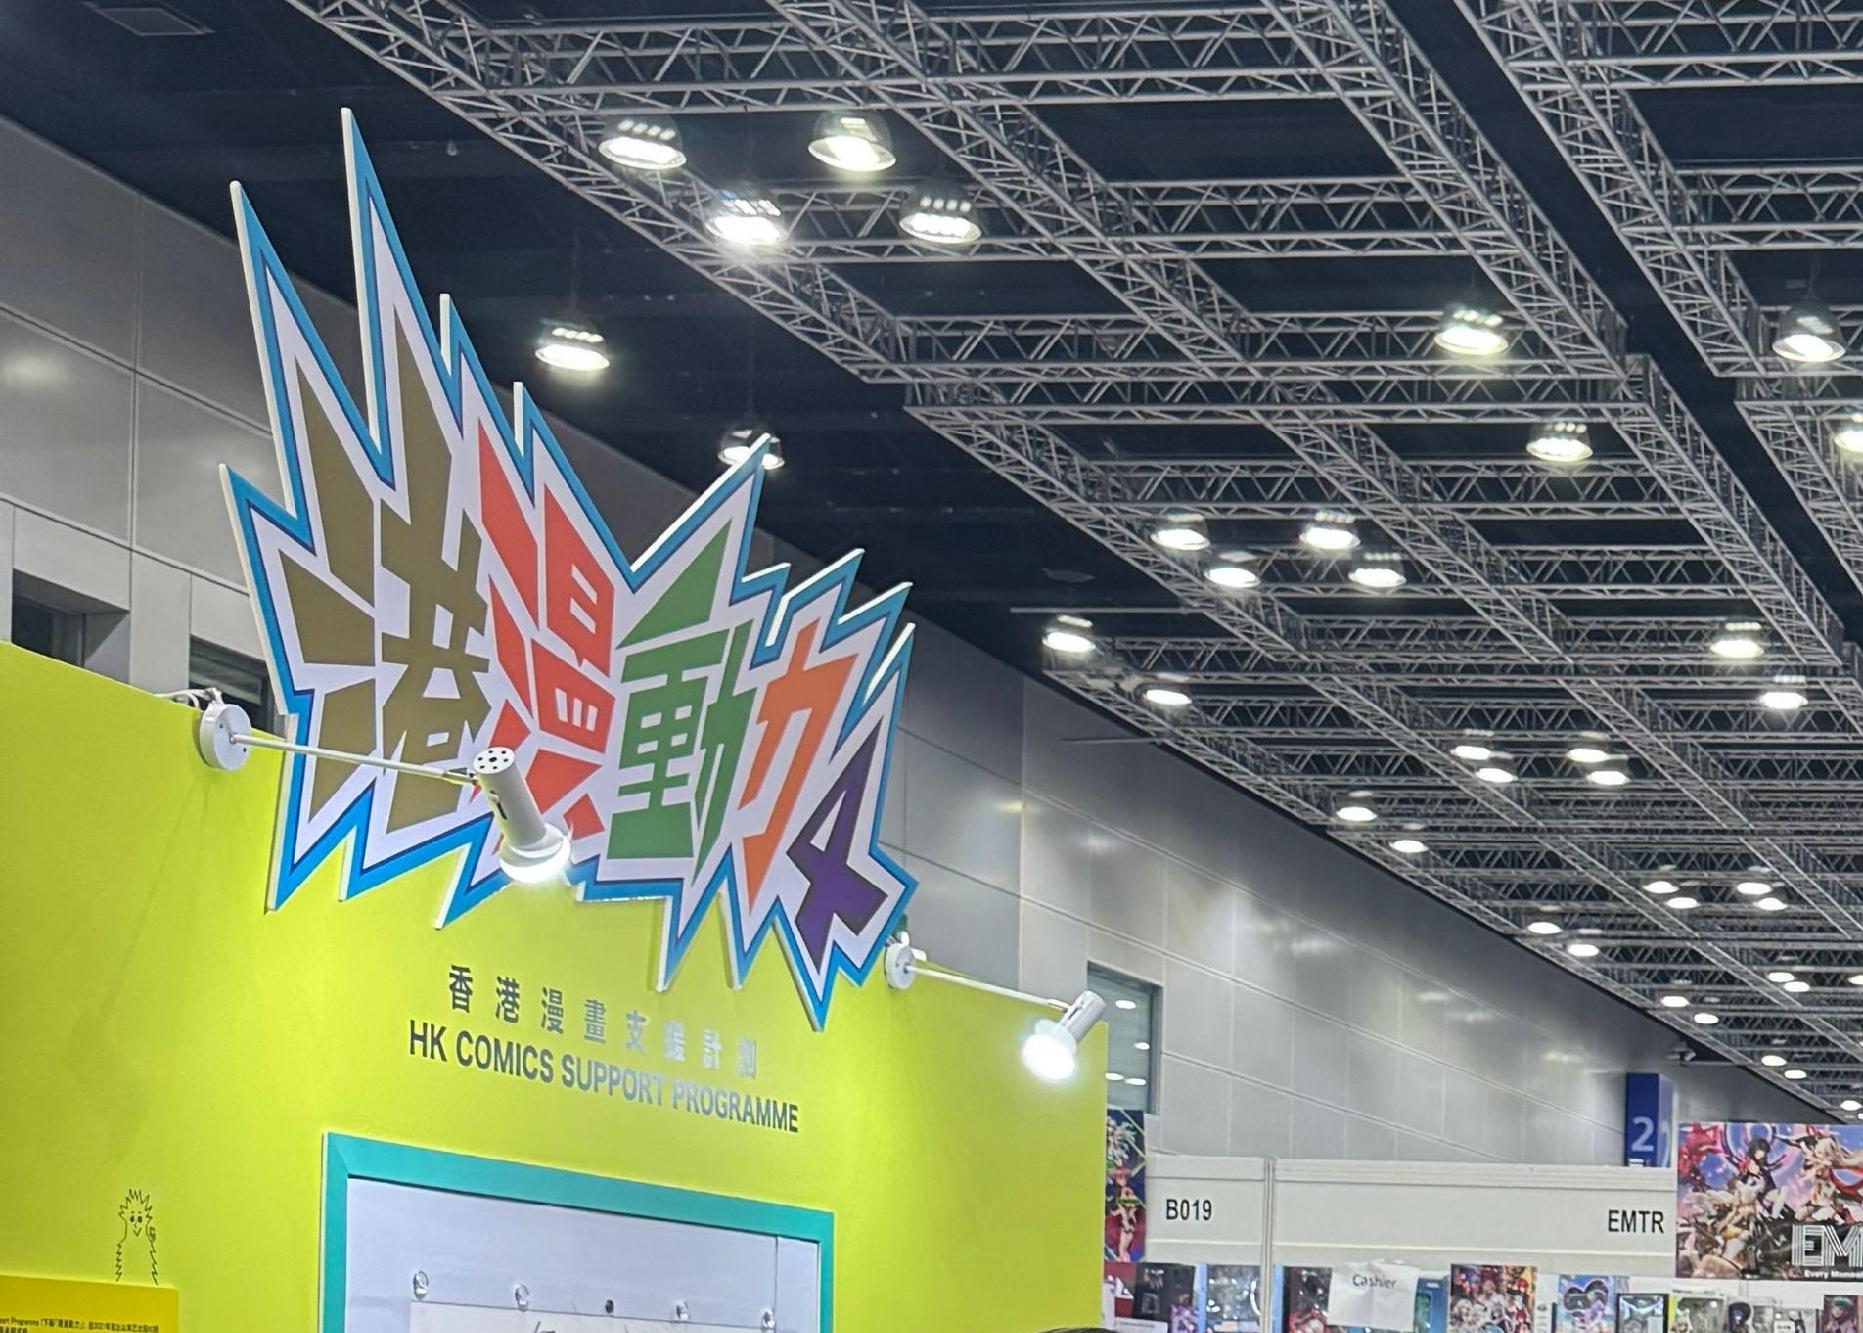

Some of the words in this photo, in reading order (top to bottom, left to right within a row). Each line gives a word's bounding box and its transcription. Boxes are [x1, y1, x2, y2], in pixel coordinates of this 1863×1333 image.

[409, 1020, 447, 1062] HK
[455, 1031, 553, 1083] COMICS
[562, 1054, 664, 1107] SUPPORT
[672, 1081, 799, 1133] PROGRAMME
[1631, 1116, 1655, 1152] 2
[1165, 1199, 1213, 1221] B019
[1608, 1210, 1665, 1234] EMTR
[1353, 1275, 1397, 1289] Cashier
